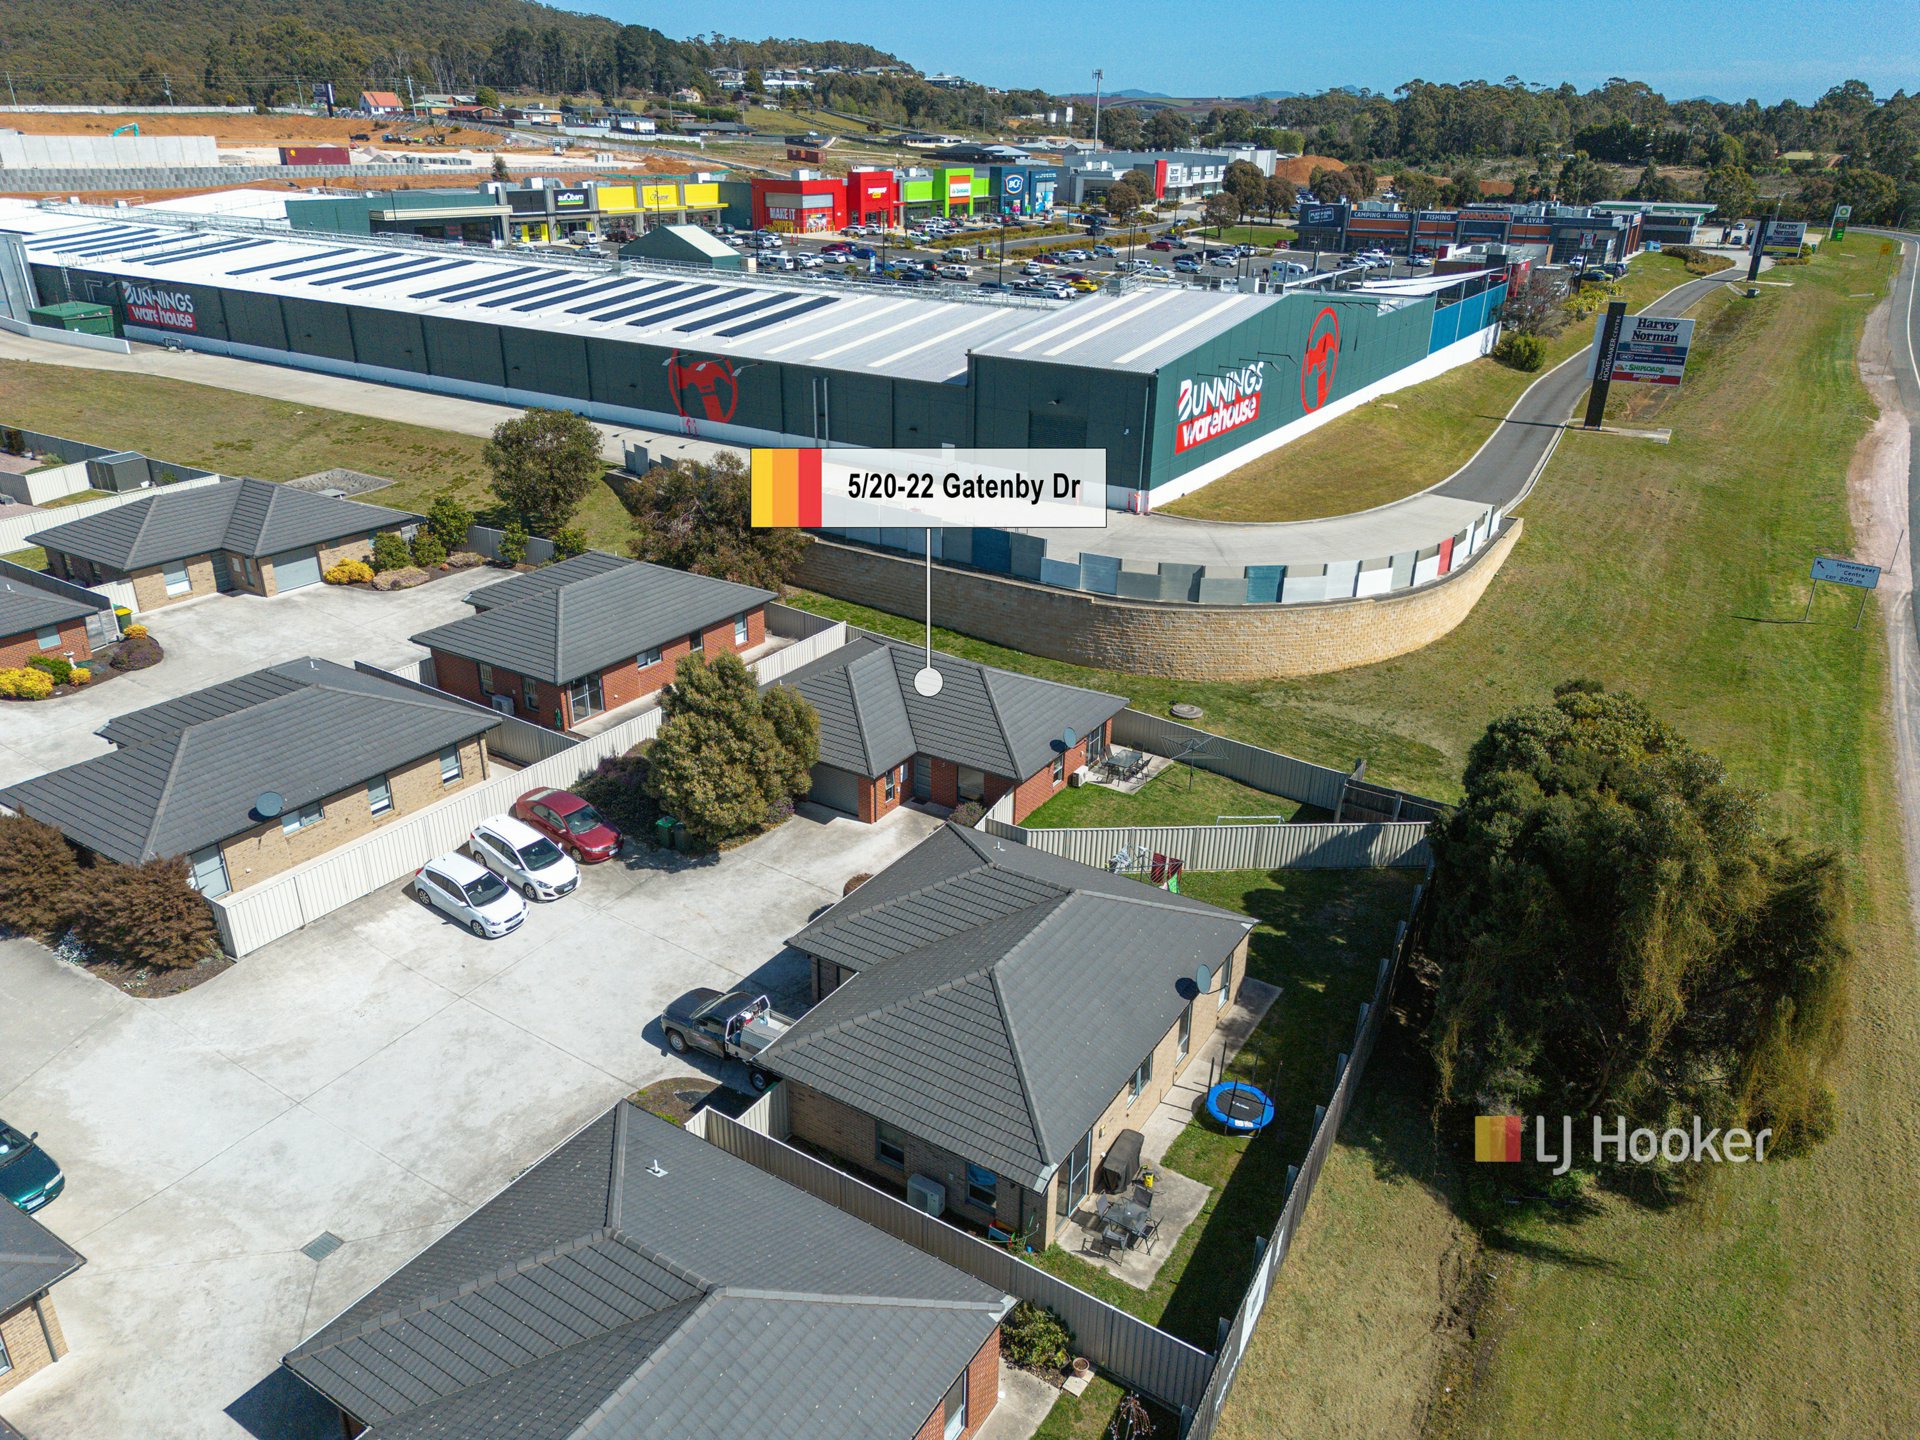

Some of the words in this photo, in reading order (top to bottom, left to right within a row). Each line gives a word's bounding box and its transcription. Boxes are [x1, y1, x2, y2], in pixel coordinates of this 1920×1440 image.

[1008, 179, 1021, 189] BCF
[769, 207, 788, 219] MAKE
[789, 208, 795, 220] IT
[1459, 211, 1511, 221] ANACONDA
[122, 280, 194, 313] BUNNINGS
[1636, 317, 1680, 332] Harvey
[1631, 329, 1679, 343] Norman
[1602, 337, 1617, 381] HOMEMAKER
[1612, 315, 1622, 338] CENTRE
[1178, 361, 1265, 421] BUNNINGS
[1182, 396, 1257, 447] warehouse
[1837, 562, 1876, 574] Homemaker
[1843, 570, 1866, 579] Centre
